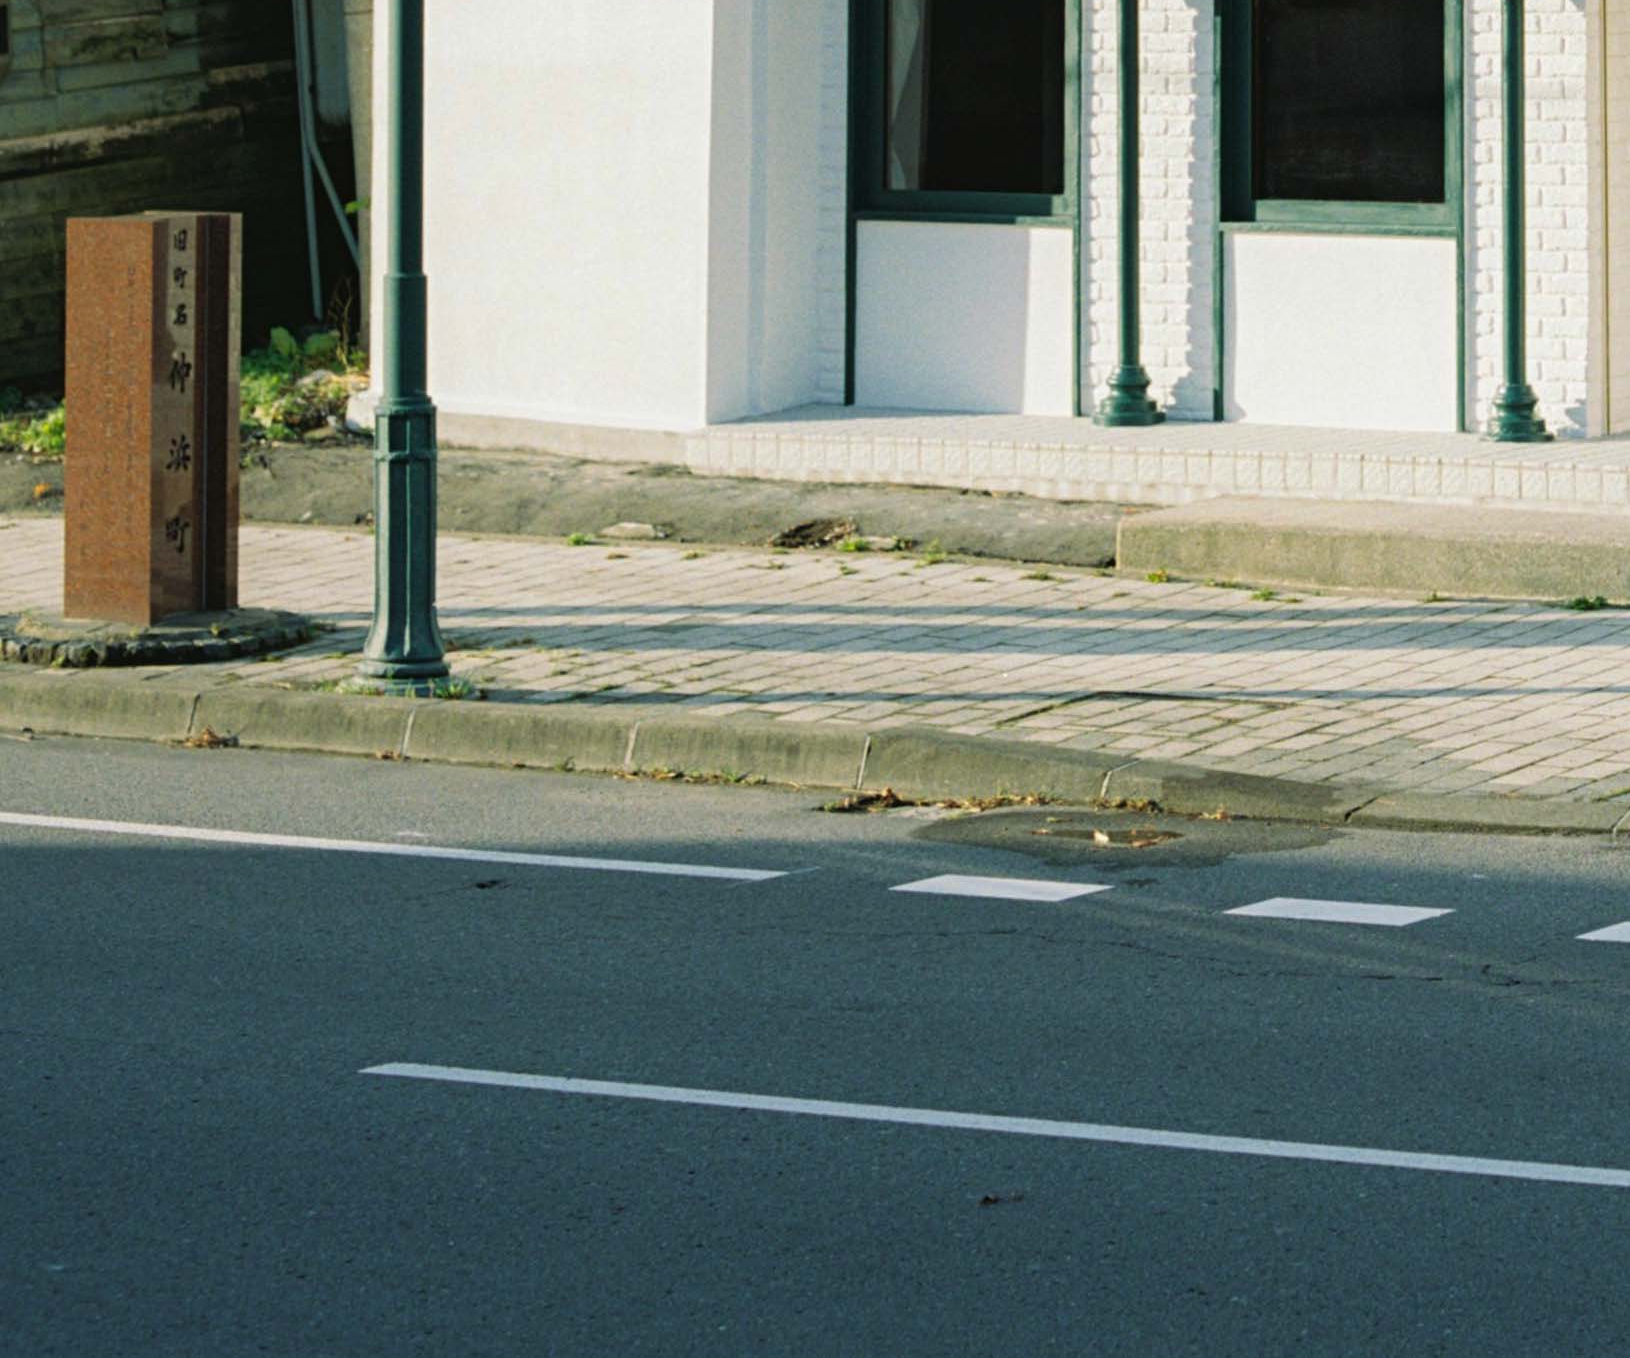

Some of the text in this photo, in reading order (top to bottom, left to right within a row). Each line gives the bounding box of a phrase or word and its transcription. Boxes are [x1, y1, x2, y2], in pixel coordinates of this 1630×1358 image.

[165, 229, 192, 554] 旧町名 仲浜町
